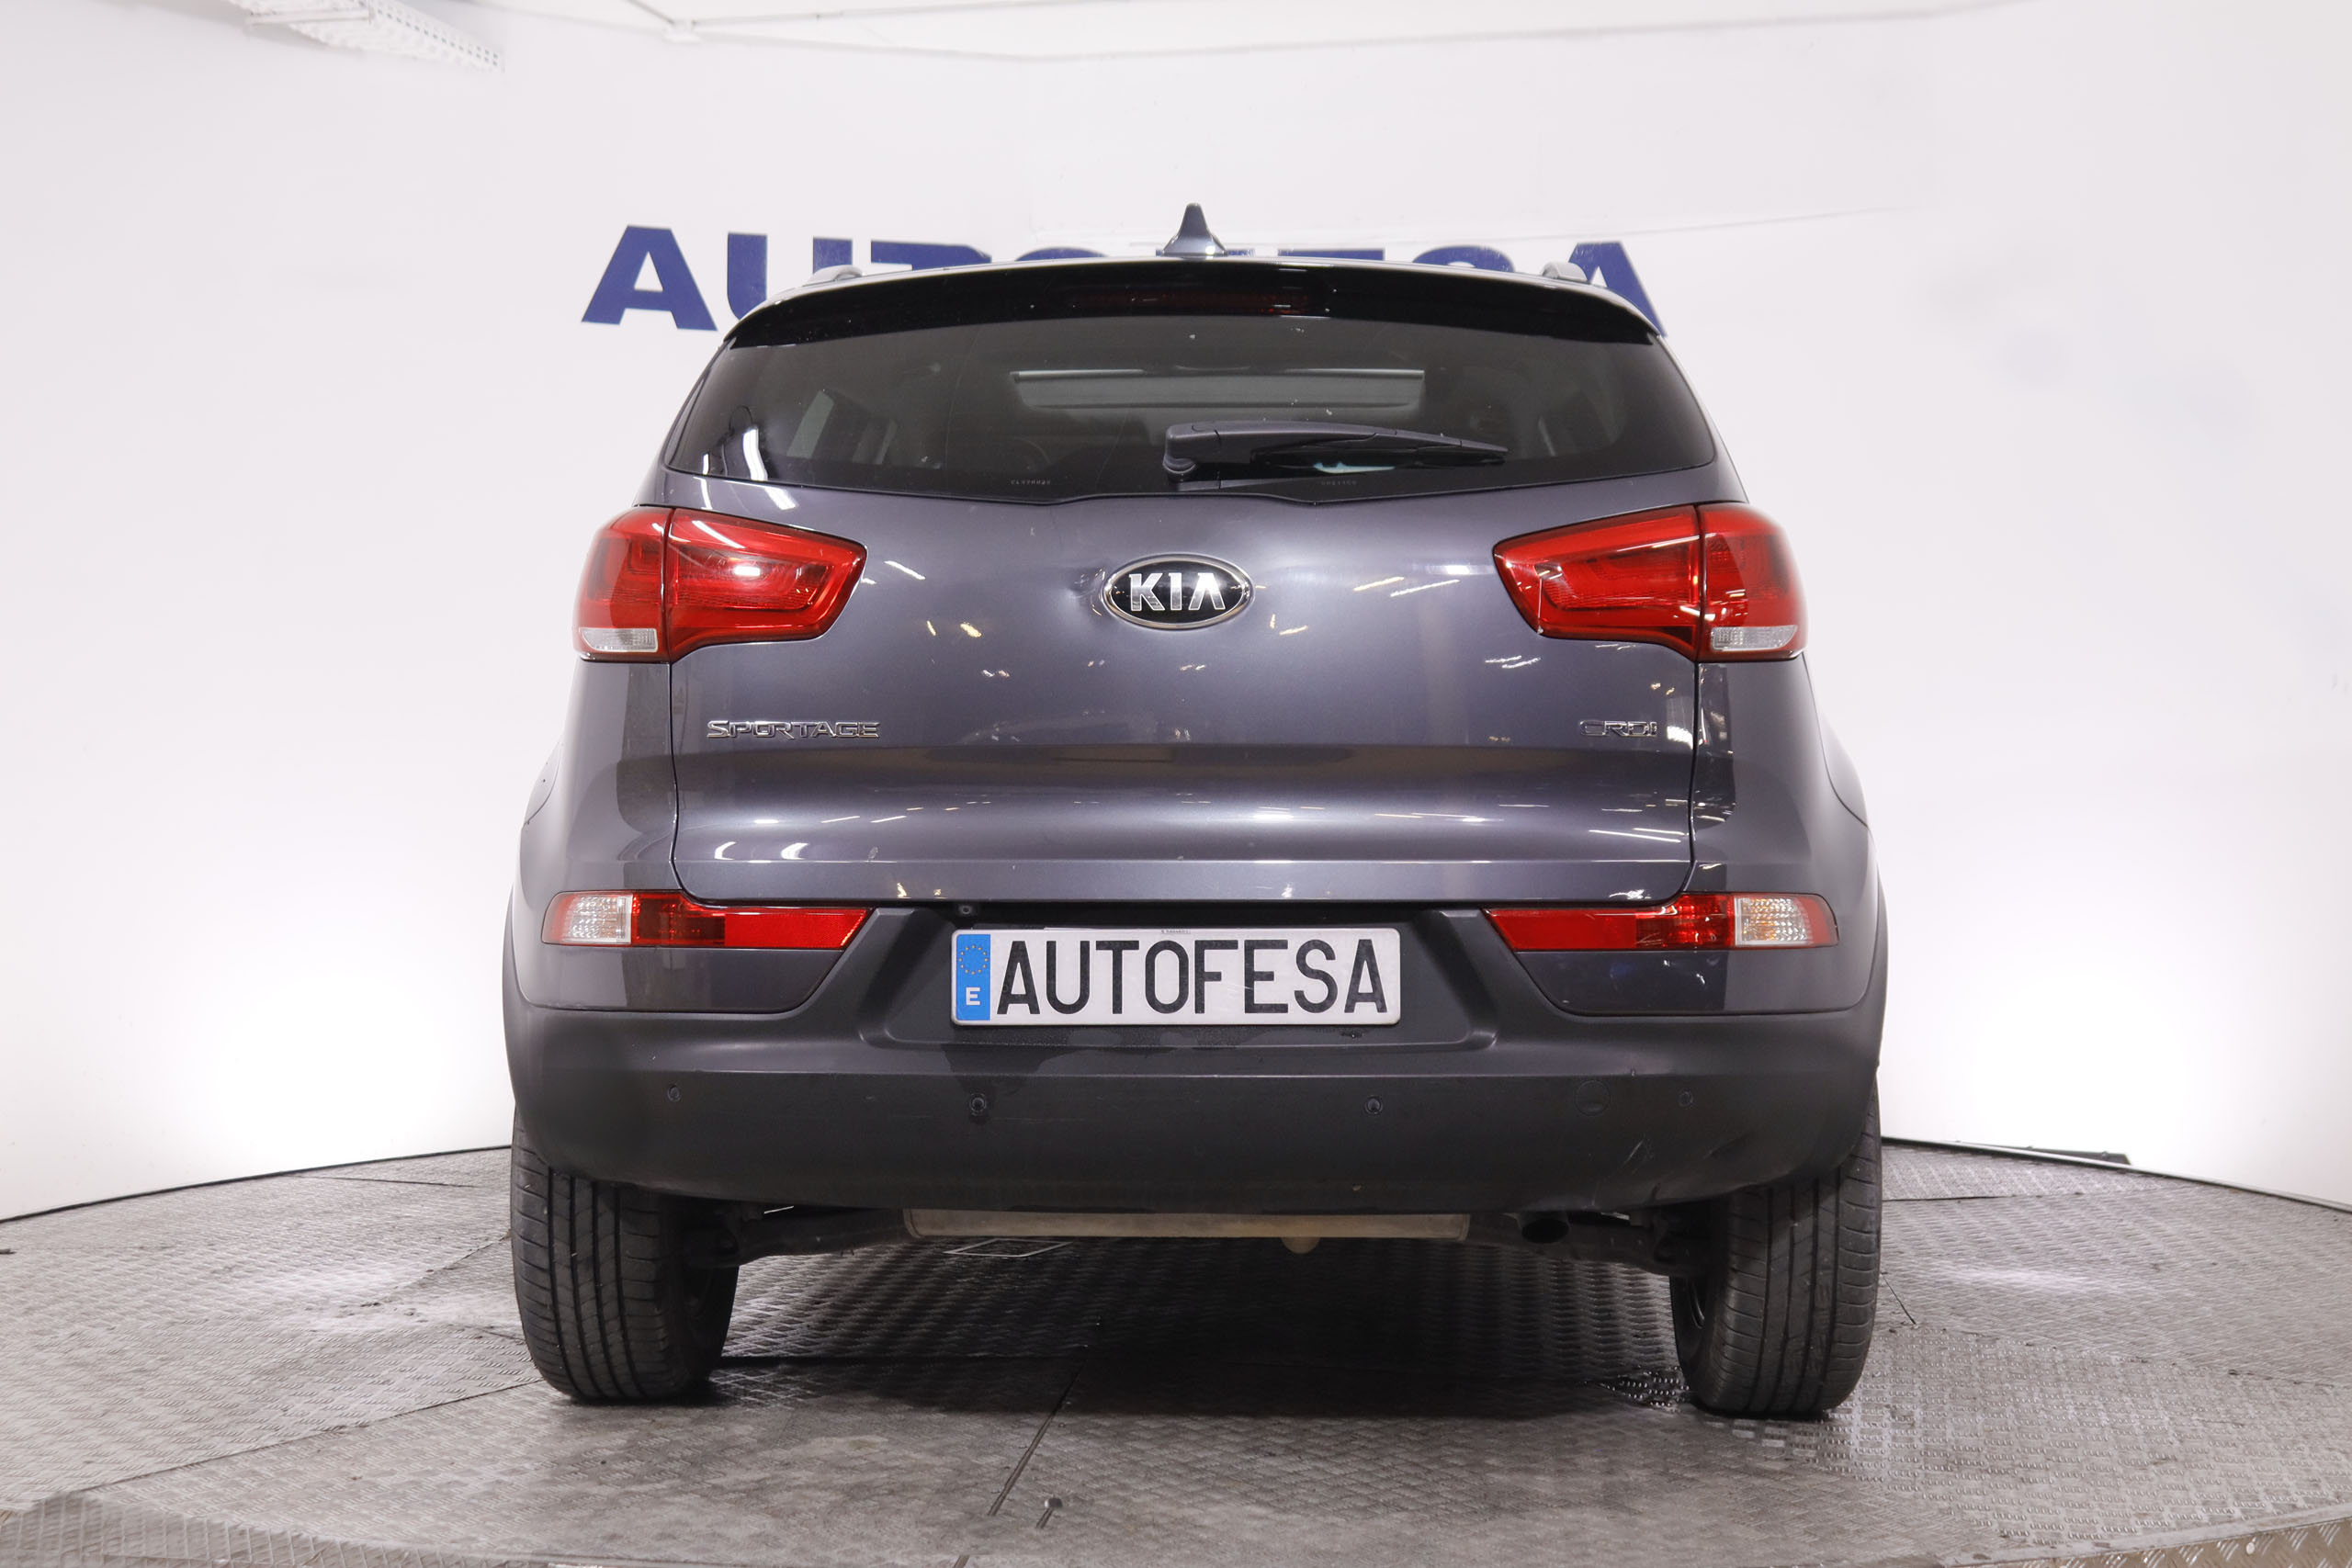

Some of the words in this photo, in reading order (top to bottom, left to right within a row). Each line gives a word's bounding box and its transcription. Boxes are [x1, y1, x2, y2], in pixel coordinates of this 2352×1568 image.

[1128, 572, 1226, 611] KIA
[707, 720, 880, 739] SPORTAGE
[966, 987, 981, 1006] E
[996, 939, 1388, 1015] AUTOFESA
